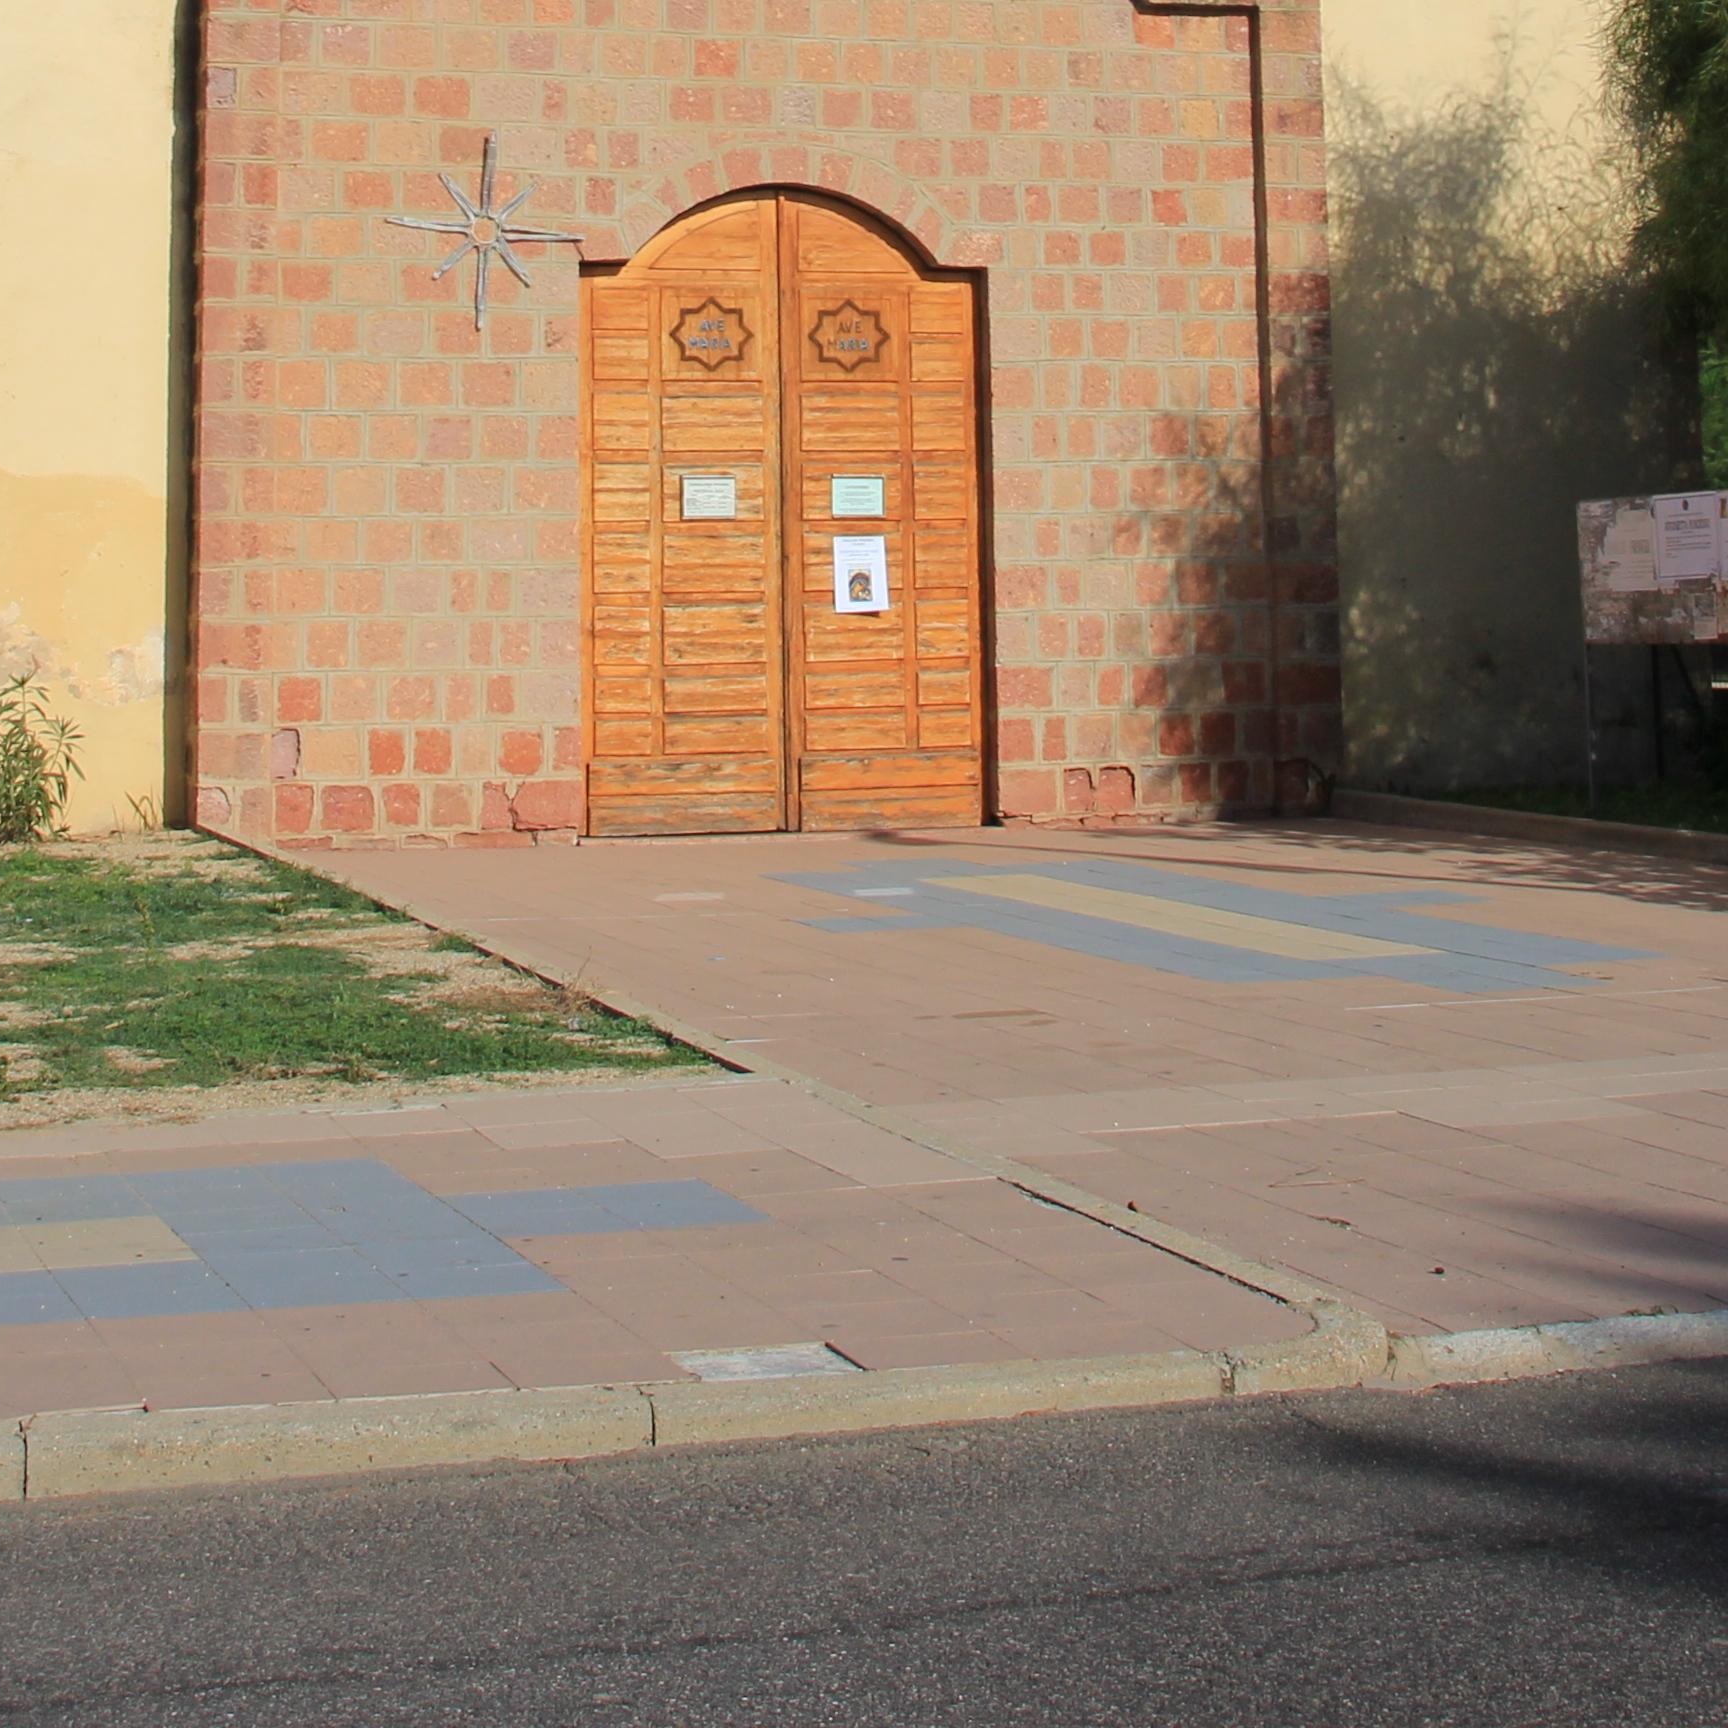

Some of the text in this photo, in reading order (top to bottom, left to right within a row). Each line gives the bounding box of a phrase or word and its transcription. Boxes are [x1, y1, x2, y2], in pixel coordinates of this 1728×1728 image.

[699, 319, 726, 332] AVE
[837, 320, 862, 333] AVE
[687, 336, 731, 350] MARIA
